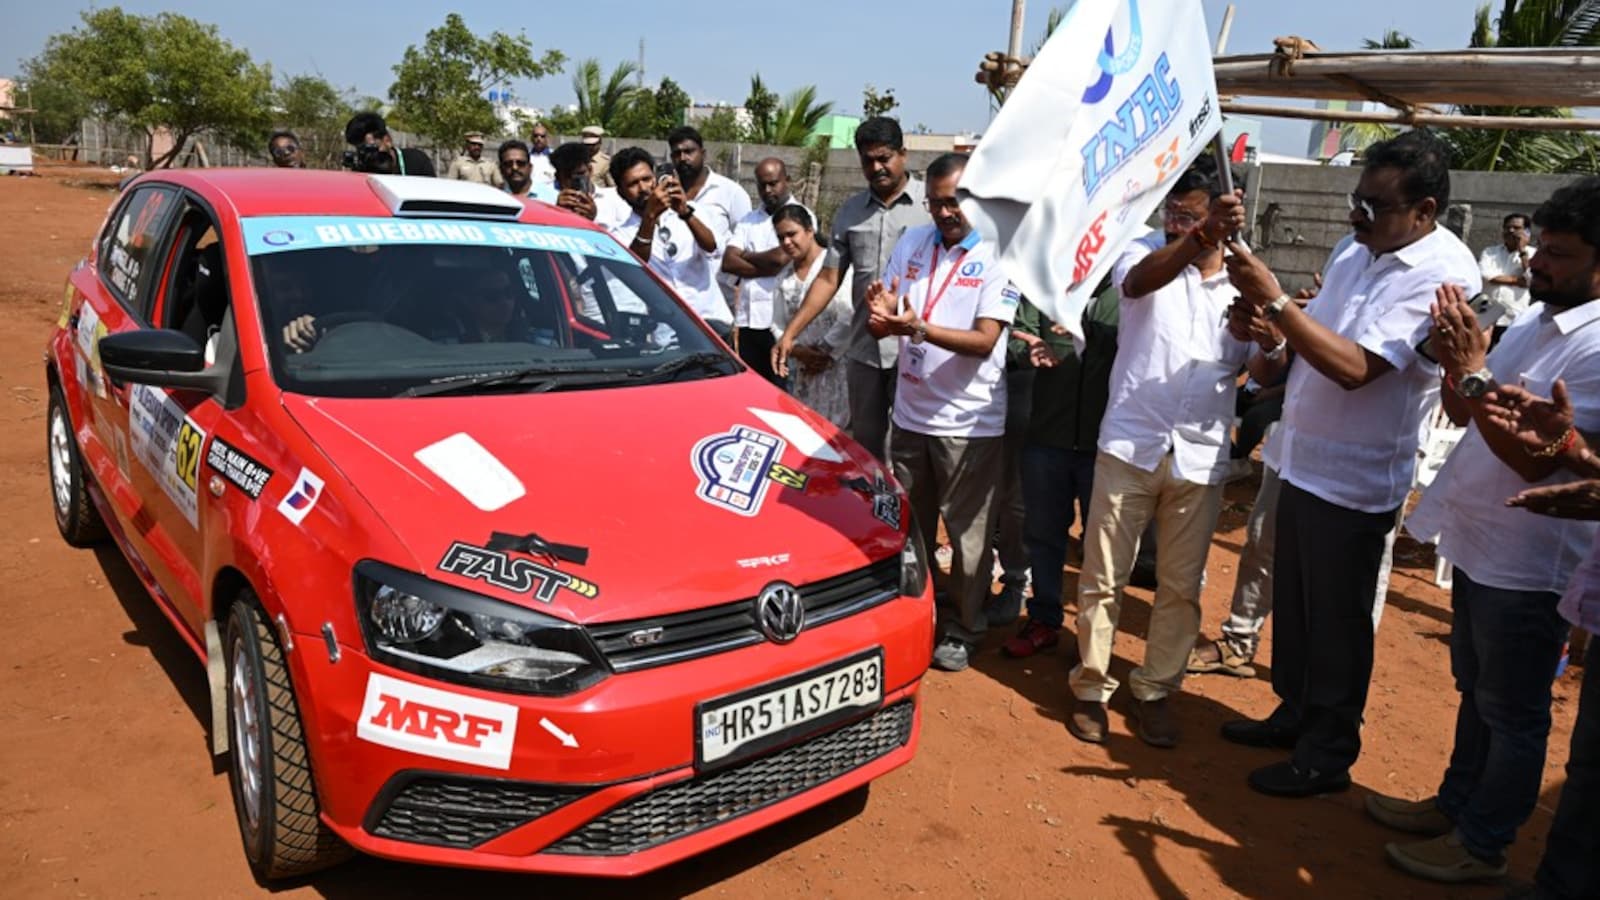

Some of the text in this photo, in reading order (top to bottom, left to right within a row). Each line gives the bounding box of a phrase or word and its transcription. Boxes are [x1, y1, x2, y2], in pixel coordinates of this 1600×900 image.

[314, 223, 596, 253] BLUEBAND SPORTS
[176, 423, 200, 490] 62
[768, 463, 807, 489] 62
[438, 543, 572, 603] FAST
[370, 693, 503, 748] MRF
[720, 663, 878, 745] HR51AS7283
[705, 725, 721, 739] IND
